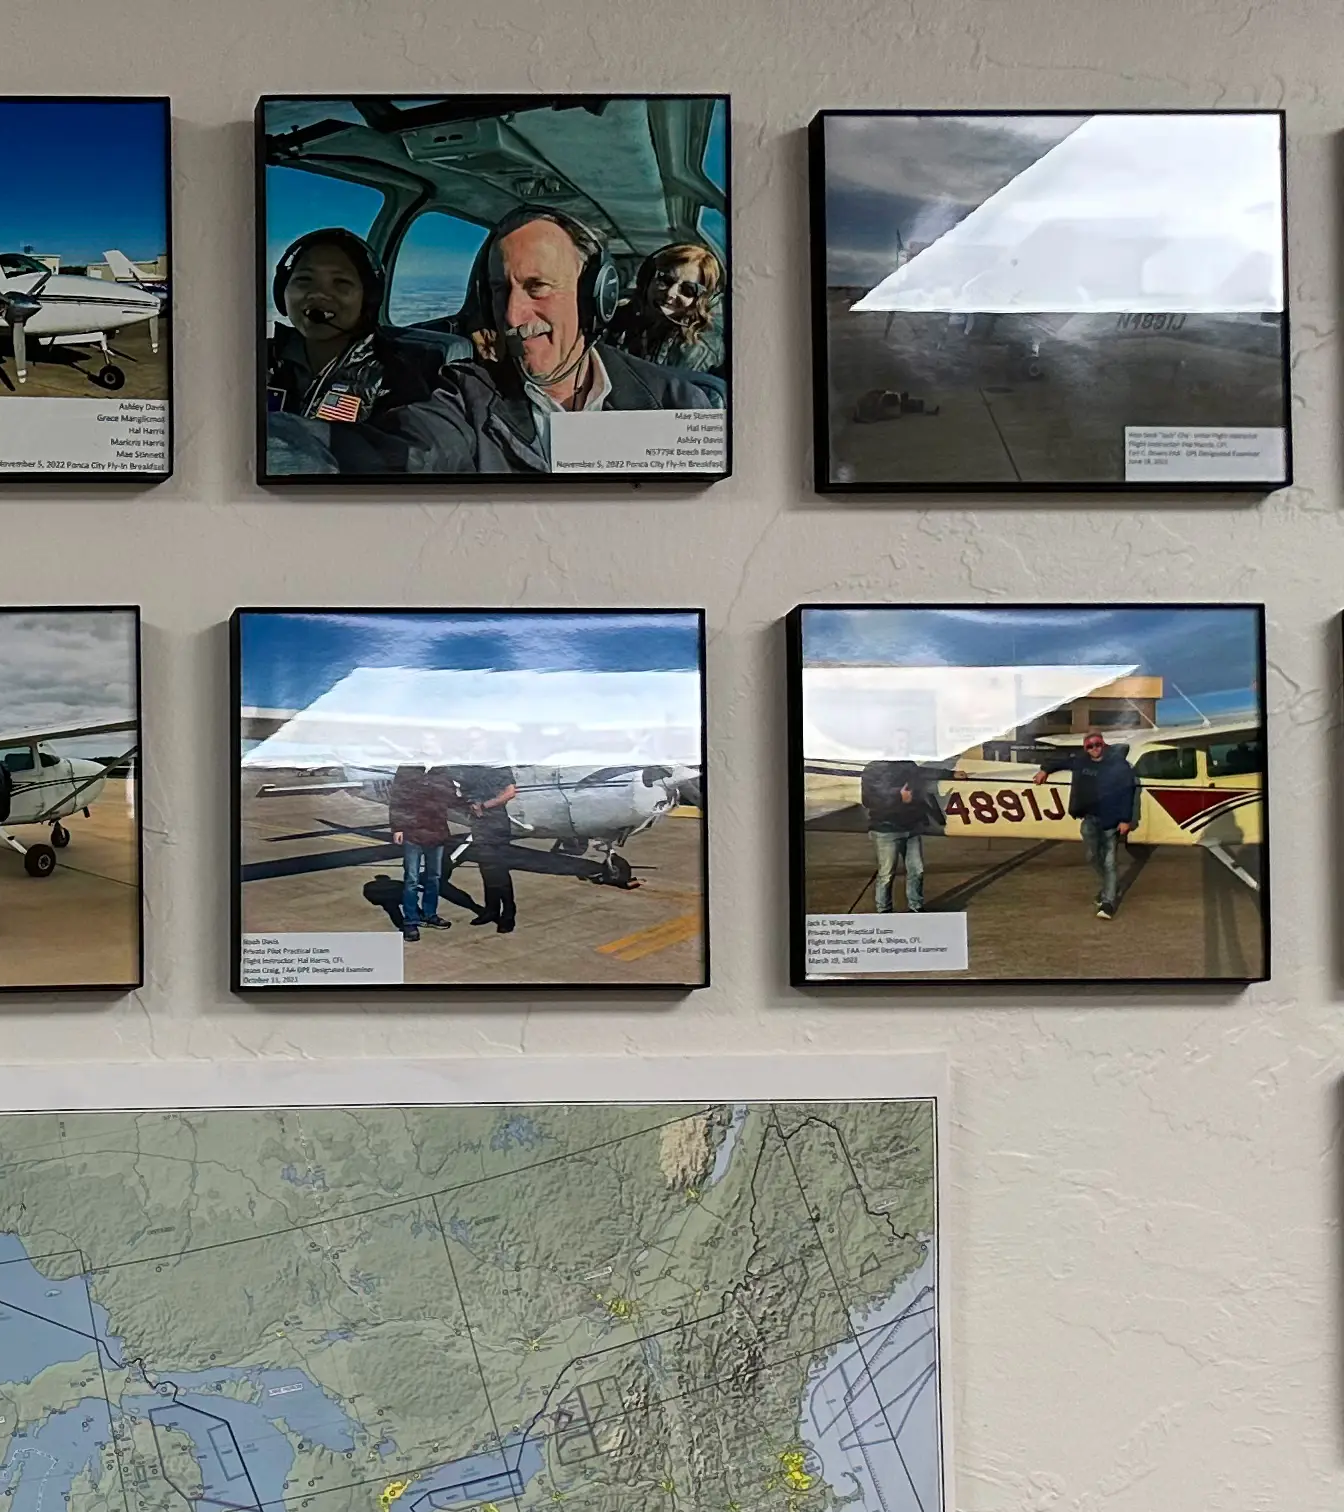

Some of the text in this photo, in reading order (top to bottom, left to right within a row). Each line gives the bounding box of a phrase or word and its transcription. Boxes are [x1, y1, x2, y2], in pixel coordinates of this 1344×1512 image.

[97, 414, 119, 422] Grace
[91, 462, 106, 470] City
[945, 787, 1066, 825] 4891J
